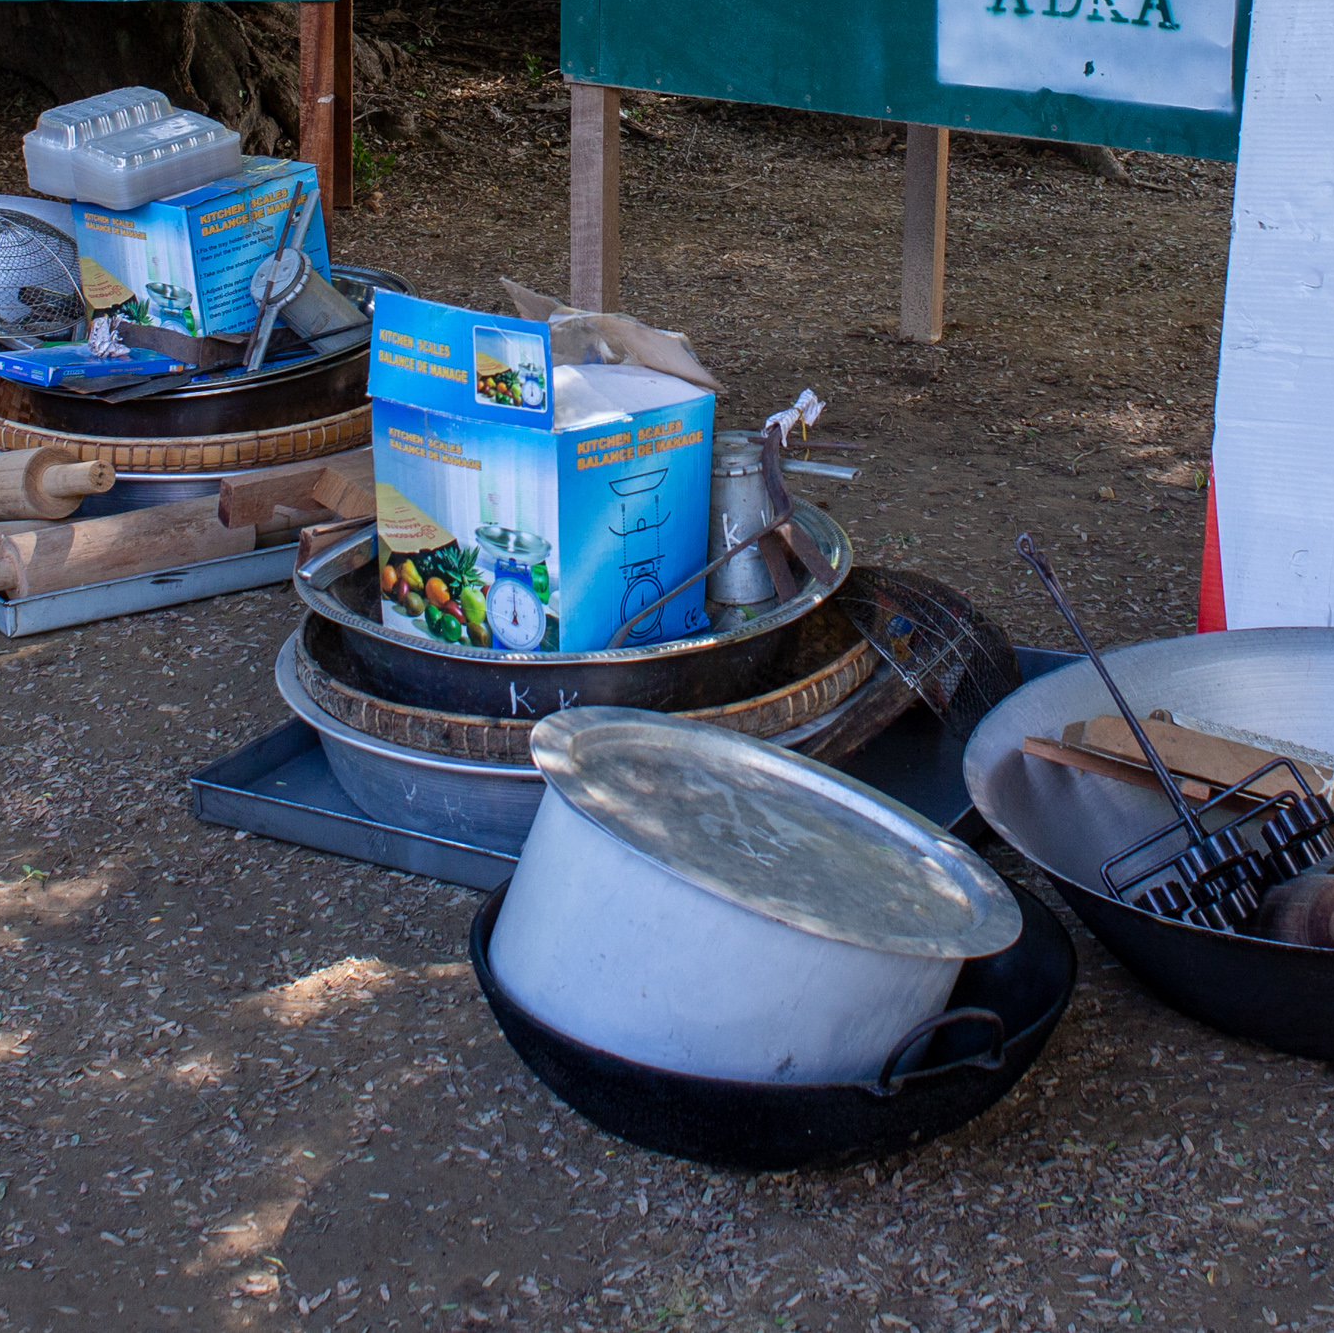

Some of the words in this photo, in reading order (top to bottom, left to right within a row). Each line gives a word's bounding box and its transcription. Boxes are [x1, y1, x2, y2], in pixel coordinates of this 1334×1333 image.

[84, 212, 110, 225] KITCHEN
[112, 216, 135, 229] SCALES
[200, 202, 246, 225] KITCHEN
[250, 188, 288, 209] SCALES
[85, 221, 112, 234] BALANCE
[201, 213, 250, 237] BALANCE
[251, 208, 266, 221] DE
[379, 328, 414, 350] KITCHEN
[417, 338, 451, 358] SCALES
[378, 349, 416, 370] BALANCE
[417, 359, 428, 375] DE
[430, 361, 469, 384] MANAGE
[388, 426, 424, 446] KITCHEN
[427, 436, 463, 455] SCALES
[576, 431, 632, 455] KITCHEN
[637, 419, 683, 442] SCALES
[576, 446, 635, 471] BALANCE
[637, 441, 653, 457] DE
[655, 429, 704, 453] MANAGE
[389, 438, 427, 458] BALANCE
[428, 449, 440, 462] DE
[441, 453, 482, 471] MANAGE
